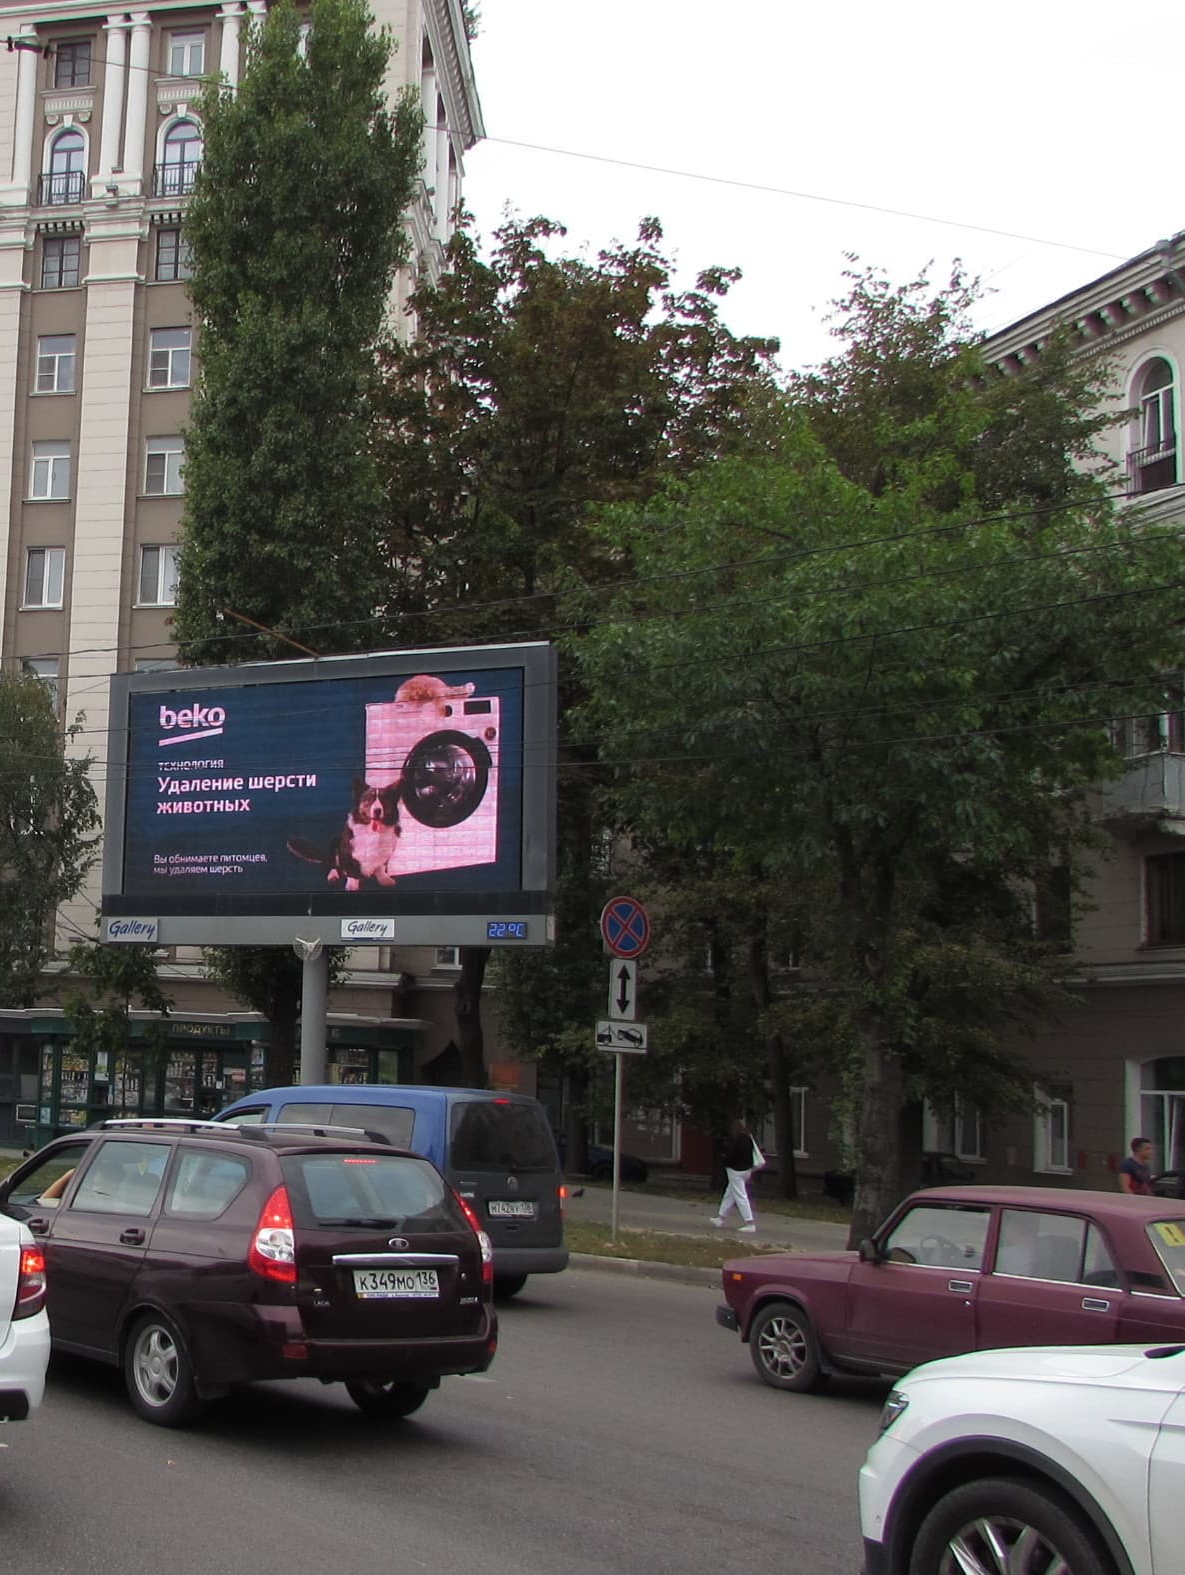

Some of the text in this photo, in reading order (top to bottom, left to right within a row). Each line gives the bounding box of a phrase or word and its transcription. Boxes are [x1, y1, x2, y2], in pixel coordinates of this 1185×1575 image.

[159, 703, 226, 729] beko
[157, 774, 317, 795] Удаление шерсти
[156, 799, 251, 814] животных
[154, 853, 268, 864] Вы обнимаете питомцев,
[153, 864, 244, 877] мы удаляем шерсть
[109, 920, 156, 940] Gallery
[347, 921, 388, 937] Gallery
[172, 1022, 231, 1036] ПРОДУКТЫ
[359, 1271, 435, 1291] К349МО 136
